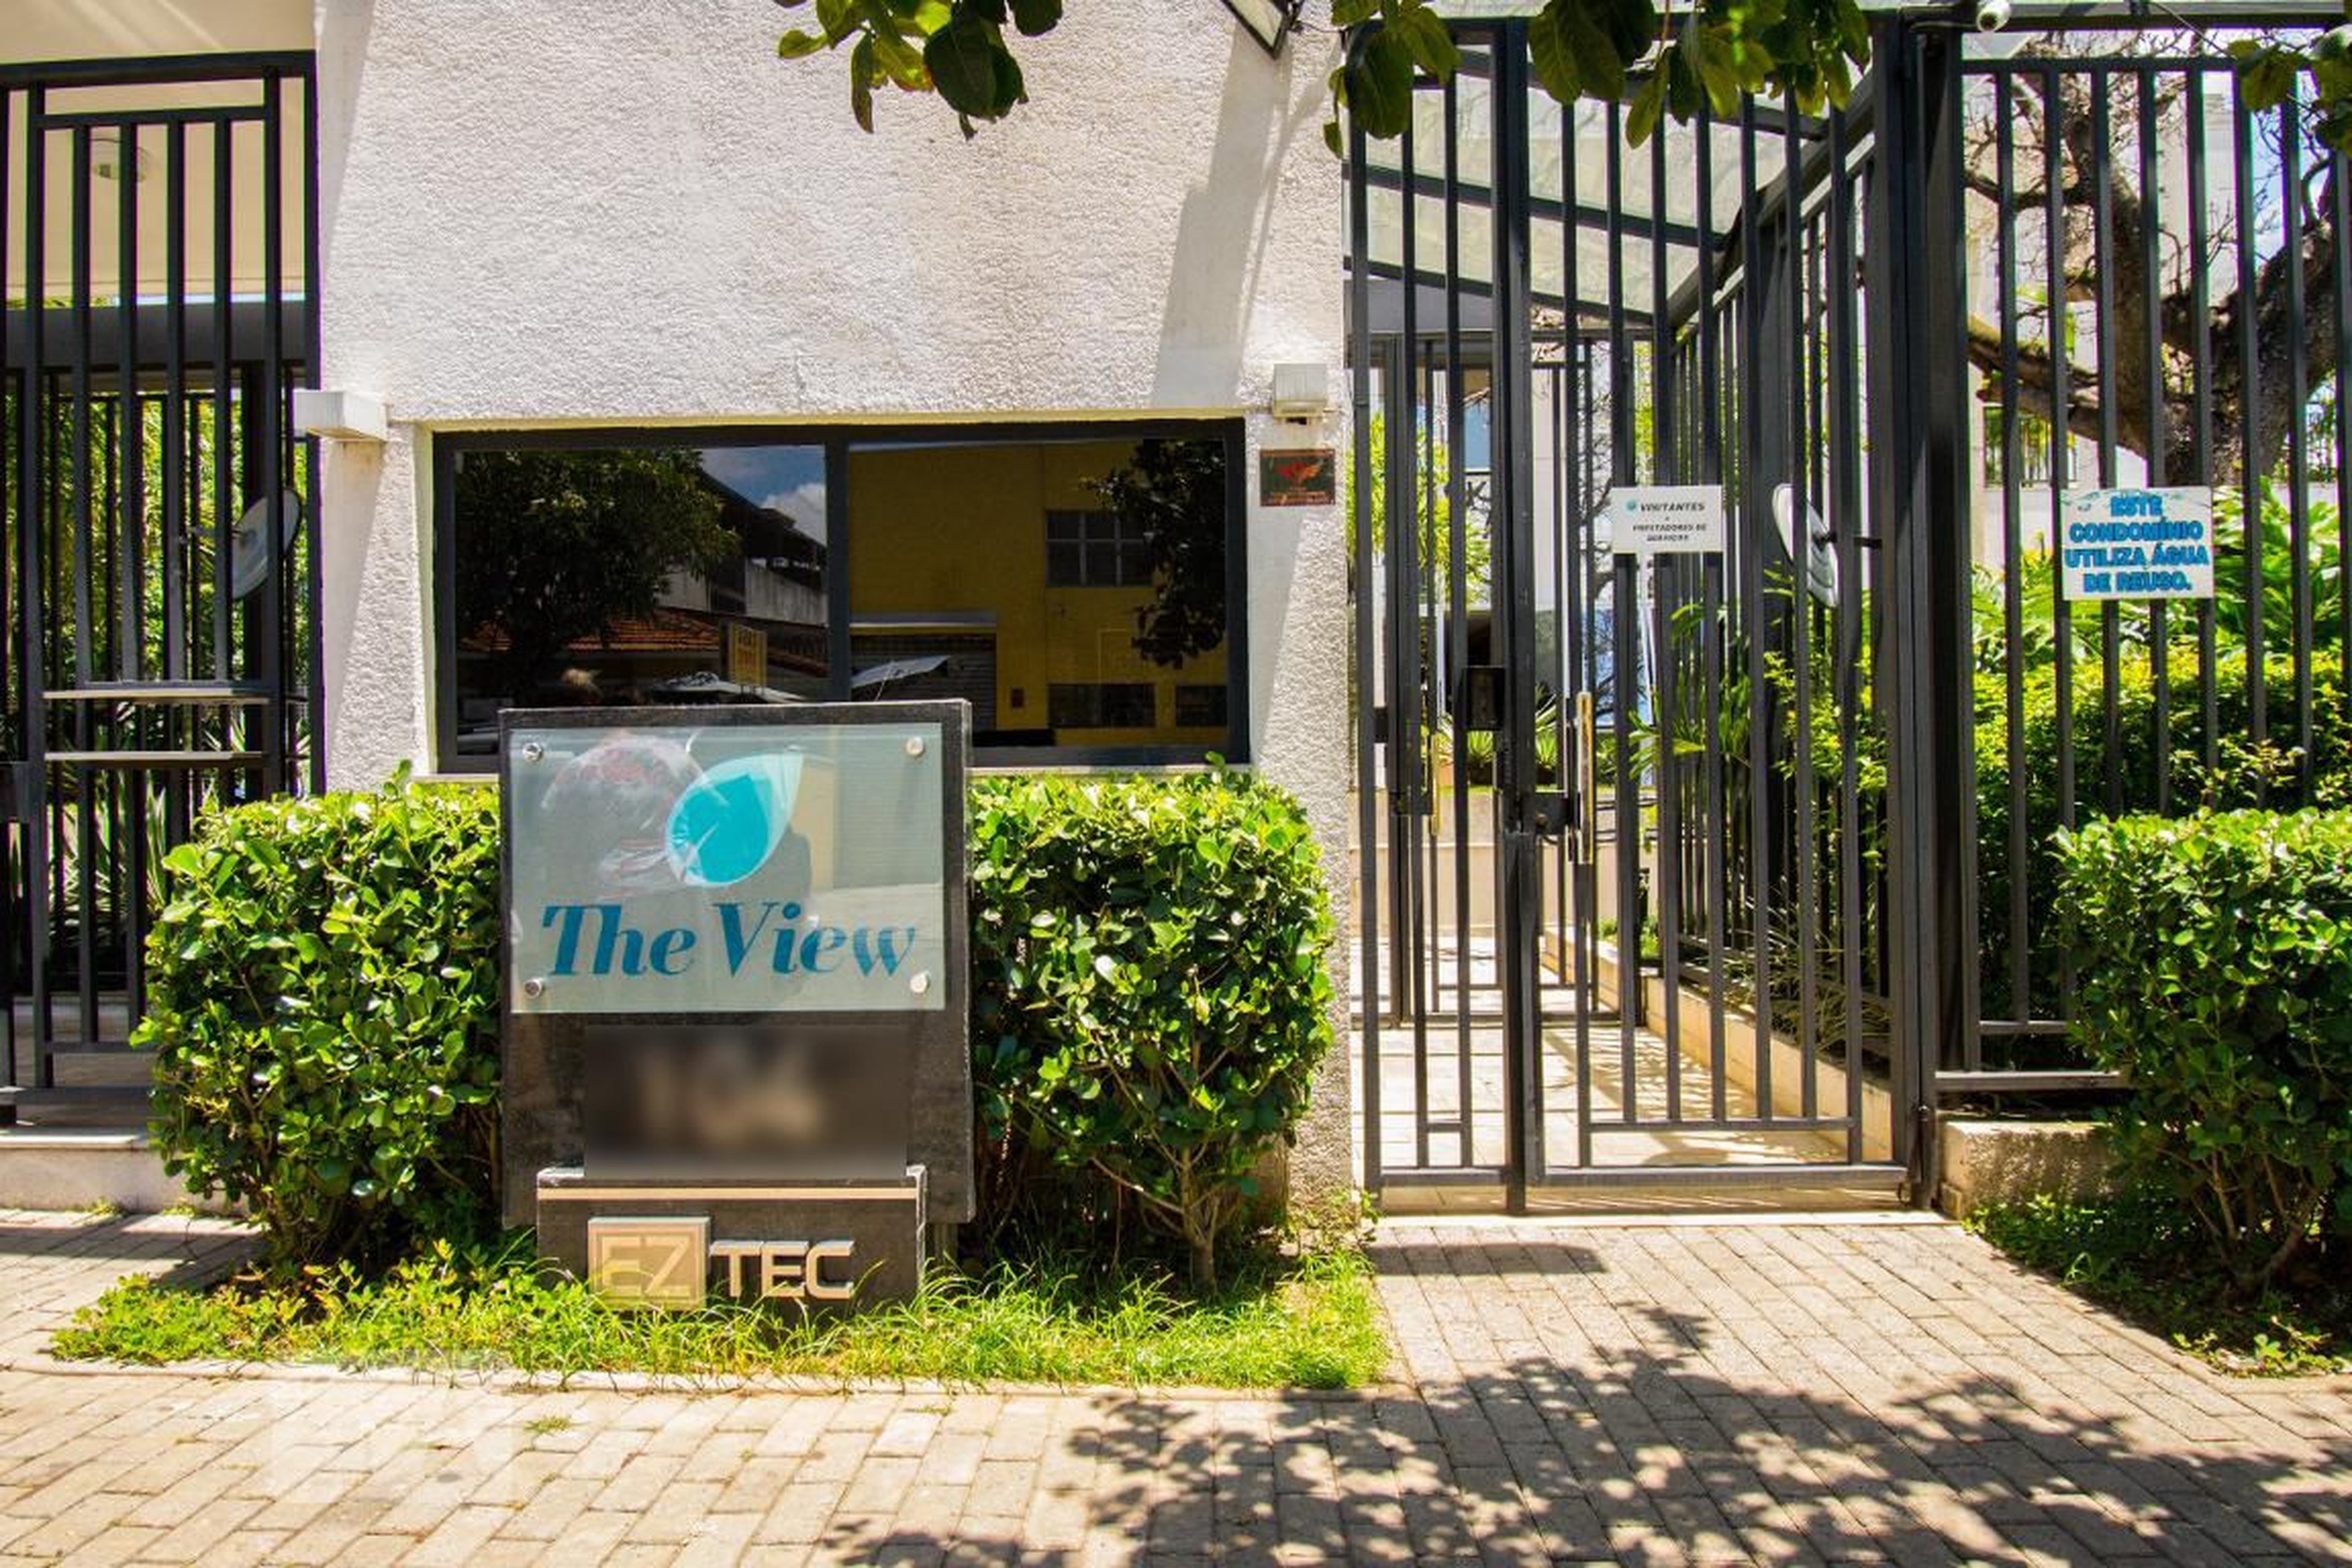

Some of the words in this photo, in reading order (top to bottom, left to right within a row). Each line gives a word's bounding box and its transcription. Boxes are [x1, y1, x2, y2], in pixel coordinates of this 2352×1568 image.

[2111, 496, 2162, 516] ESTE
[2070, 516, 2203, 543] CONDOMÍNIO
[2065, 548, 2146, 568] UTILIZA
[2152, 542, 2209, 565] ÁGUA
[2084, 573, 2111, 592] DE
[2116, 570, 2192, 592] REUSO.
[542, 903, 696, 976] The
[710, 902, 916, 979] View
